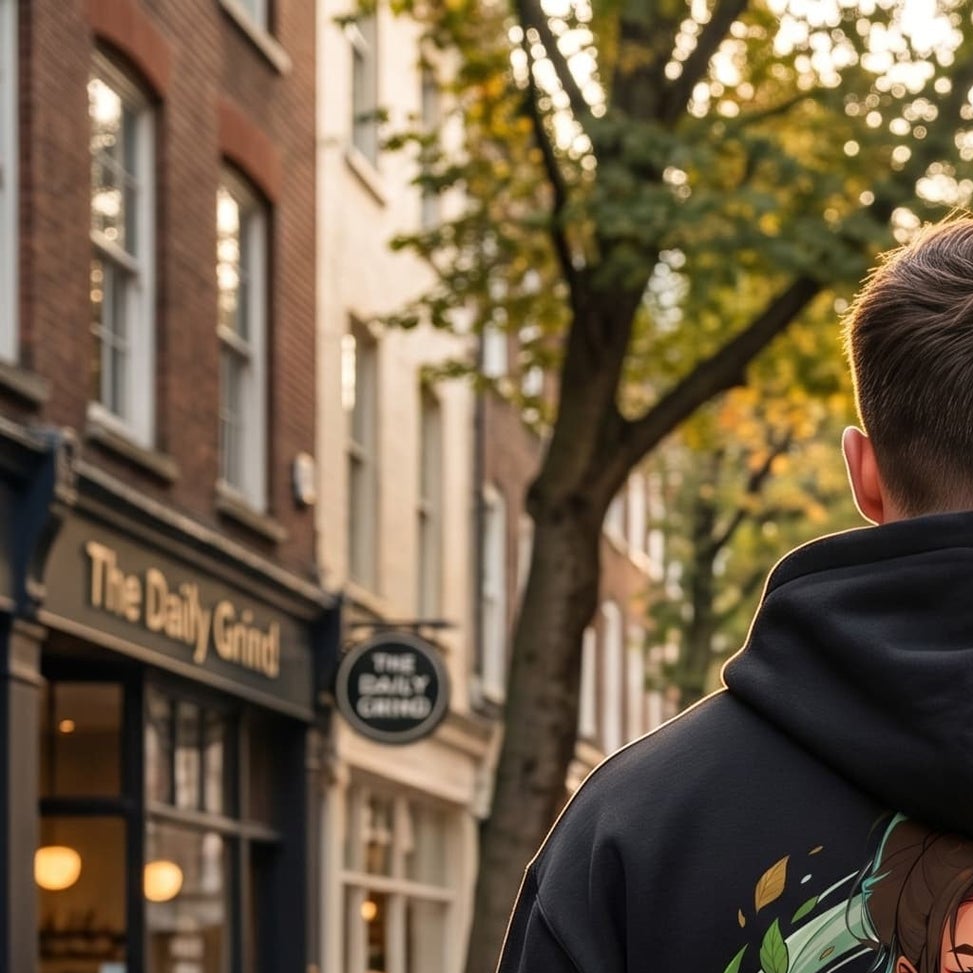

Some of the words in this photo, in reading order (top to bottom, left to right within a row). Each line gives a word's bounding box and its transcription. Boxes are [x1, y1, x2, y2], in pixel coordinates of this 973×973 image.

[86, 541, 141, 622] The
[146, 567, 213, 664] Daily
[213, 601, 281, 678] Grind
[372, 652, 416, 674] THE
[358, 673, 430, 697] DAILY
